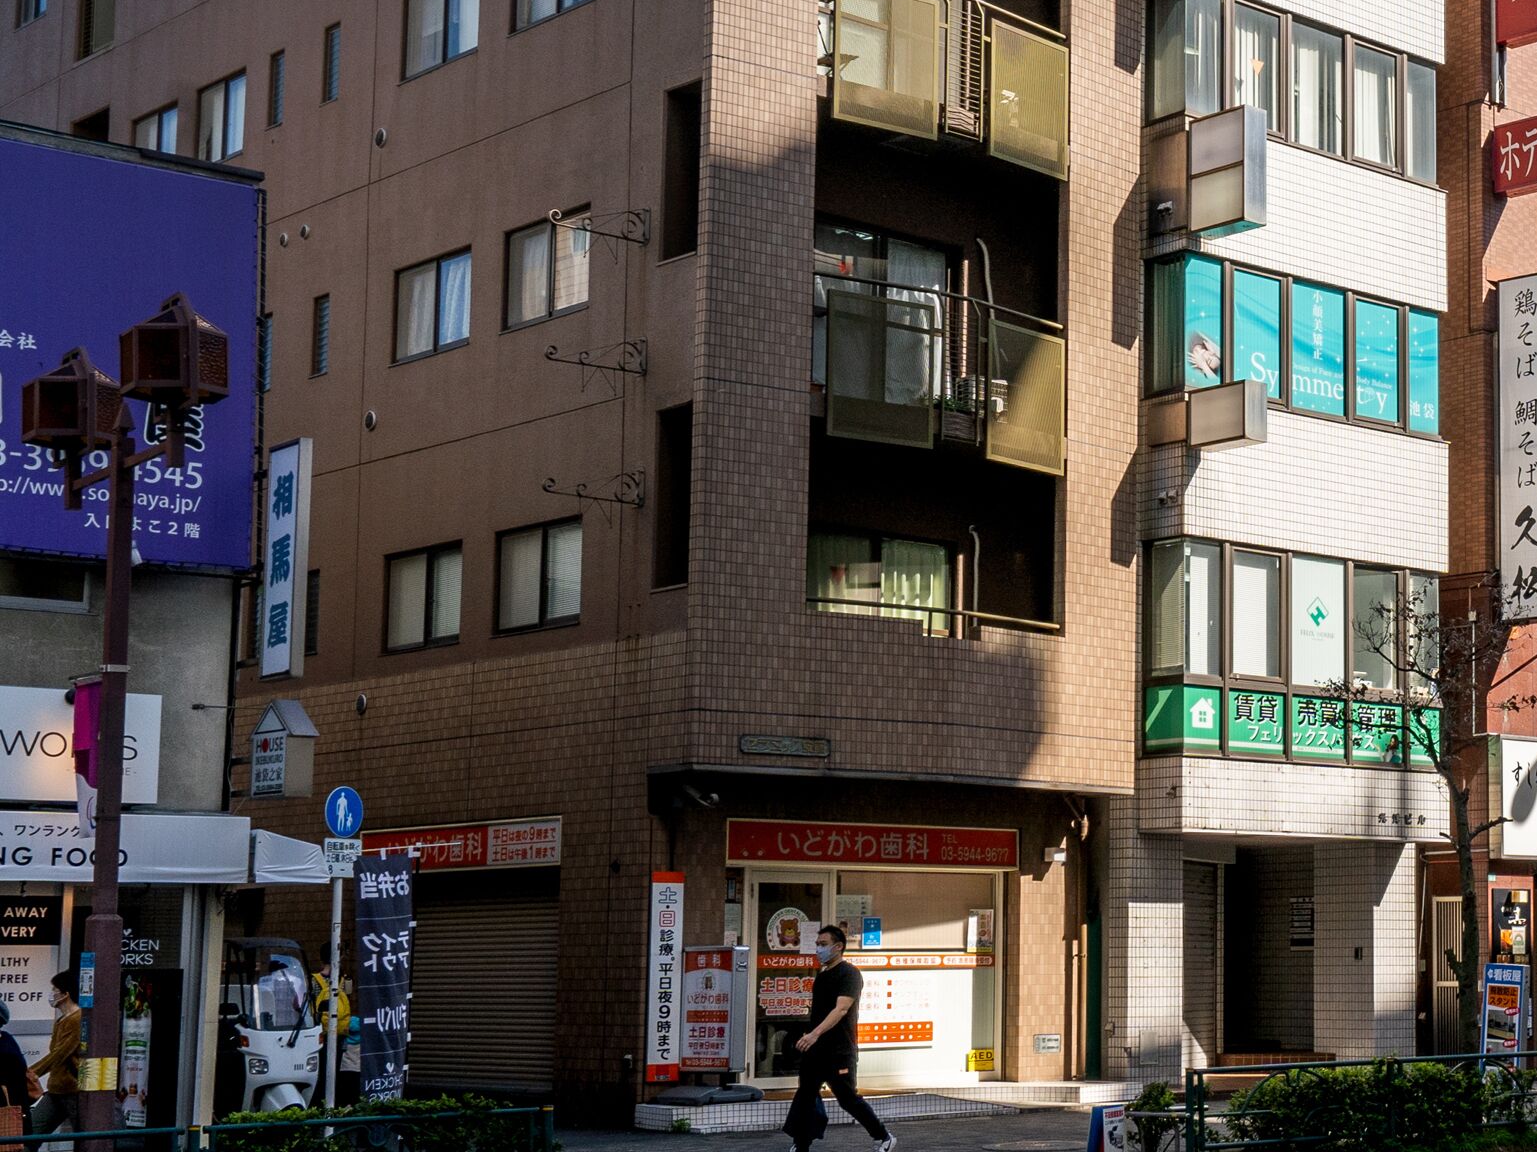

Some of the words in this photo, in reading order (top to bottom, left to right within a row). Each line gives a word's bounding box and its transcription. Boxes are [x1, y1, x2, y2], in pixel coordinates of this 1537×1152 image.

[1250, 351, 1388, 415] Symmety
[1409, 400, 1435, 421] 池袋
[266, 470, 295, 649] 相馬屋
[1234, 693, 1278, 725] 賃貸
[777, 829, 930, 861] いどがわ歯科
[4, 907, 48, 918] AWAY
[762, 956, 815, 967] いどがわ歯科
[760, 976, 815, 994] 土日診療
[18, 992, 43, 1002] OFF
[687, 992, 729, 1005] いどがわ歯科
[688, 1026, 726, 1040] 土日診療
[970, 1051, 993, 1061] AED
